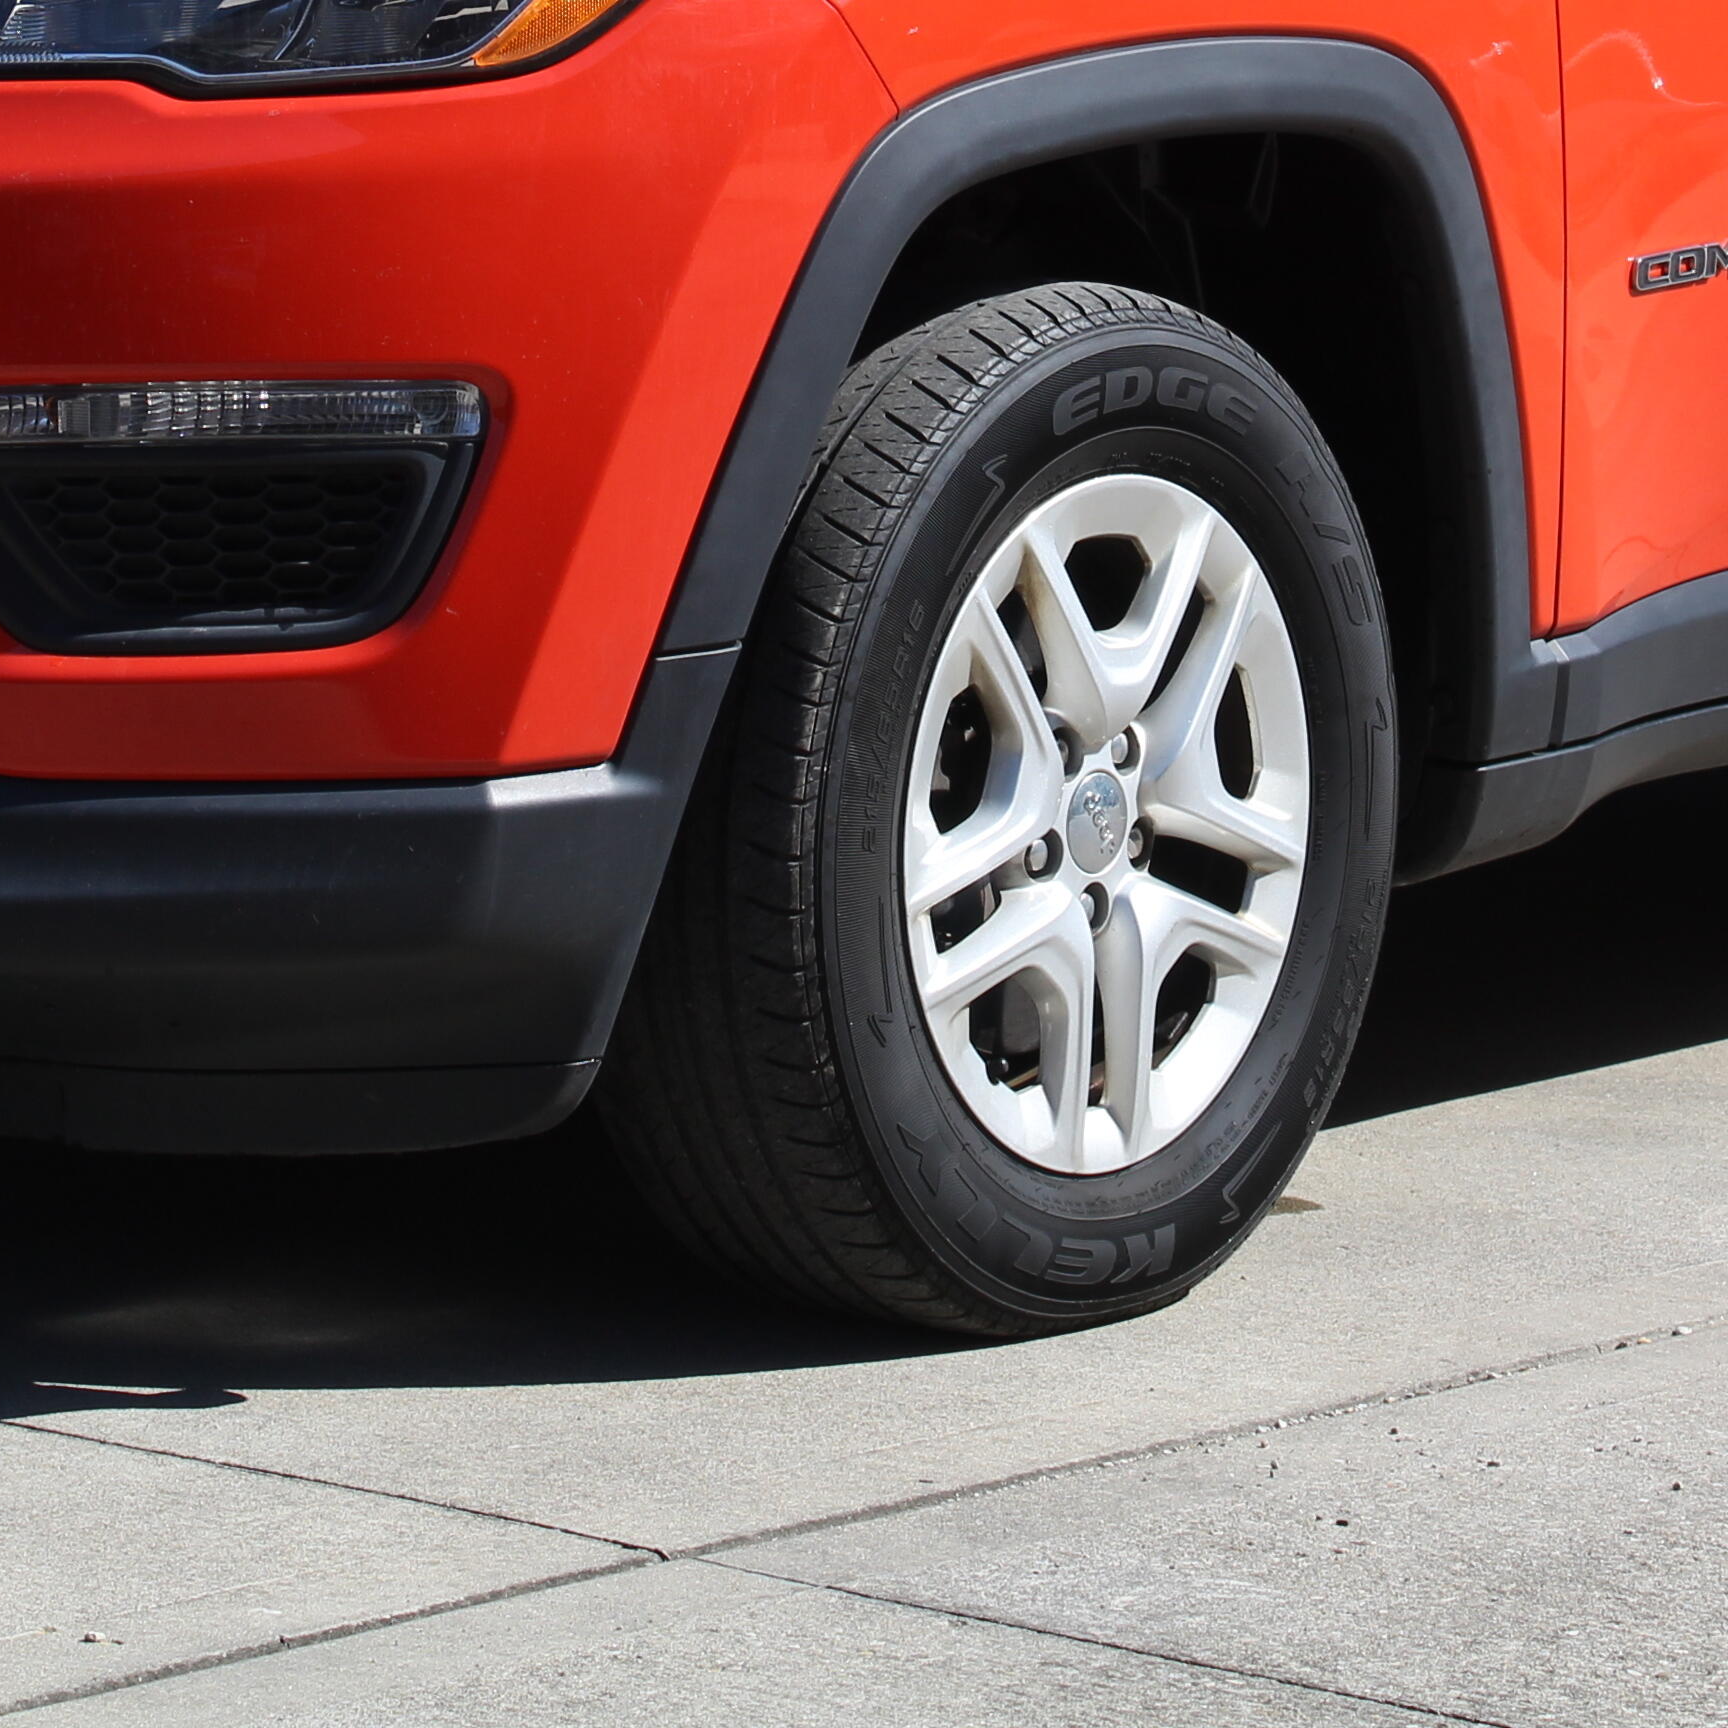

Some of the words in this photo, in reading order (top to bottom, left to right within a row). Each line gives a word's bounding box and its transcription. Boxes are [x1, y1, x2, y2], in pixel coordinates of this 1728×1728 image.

[1051, 365, 1259, 437] EDGE
[1274, 448, 1378, 629] A/S
[895, 1119, 1178, 1286] KELLY
